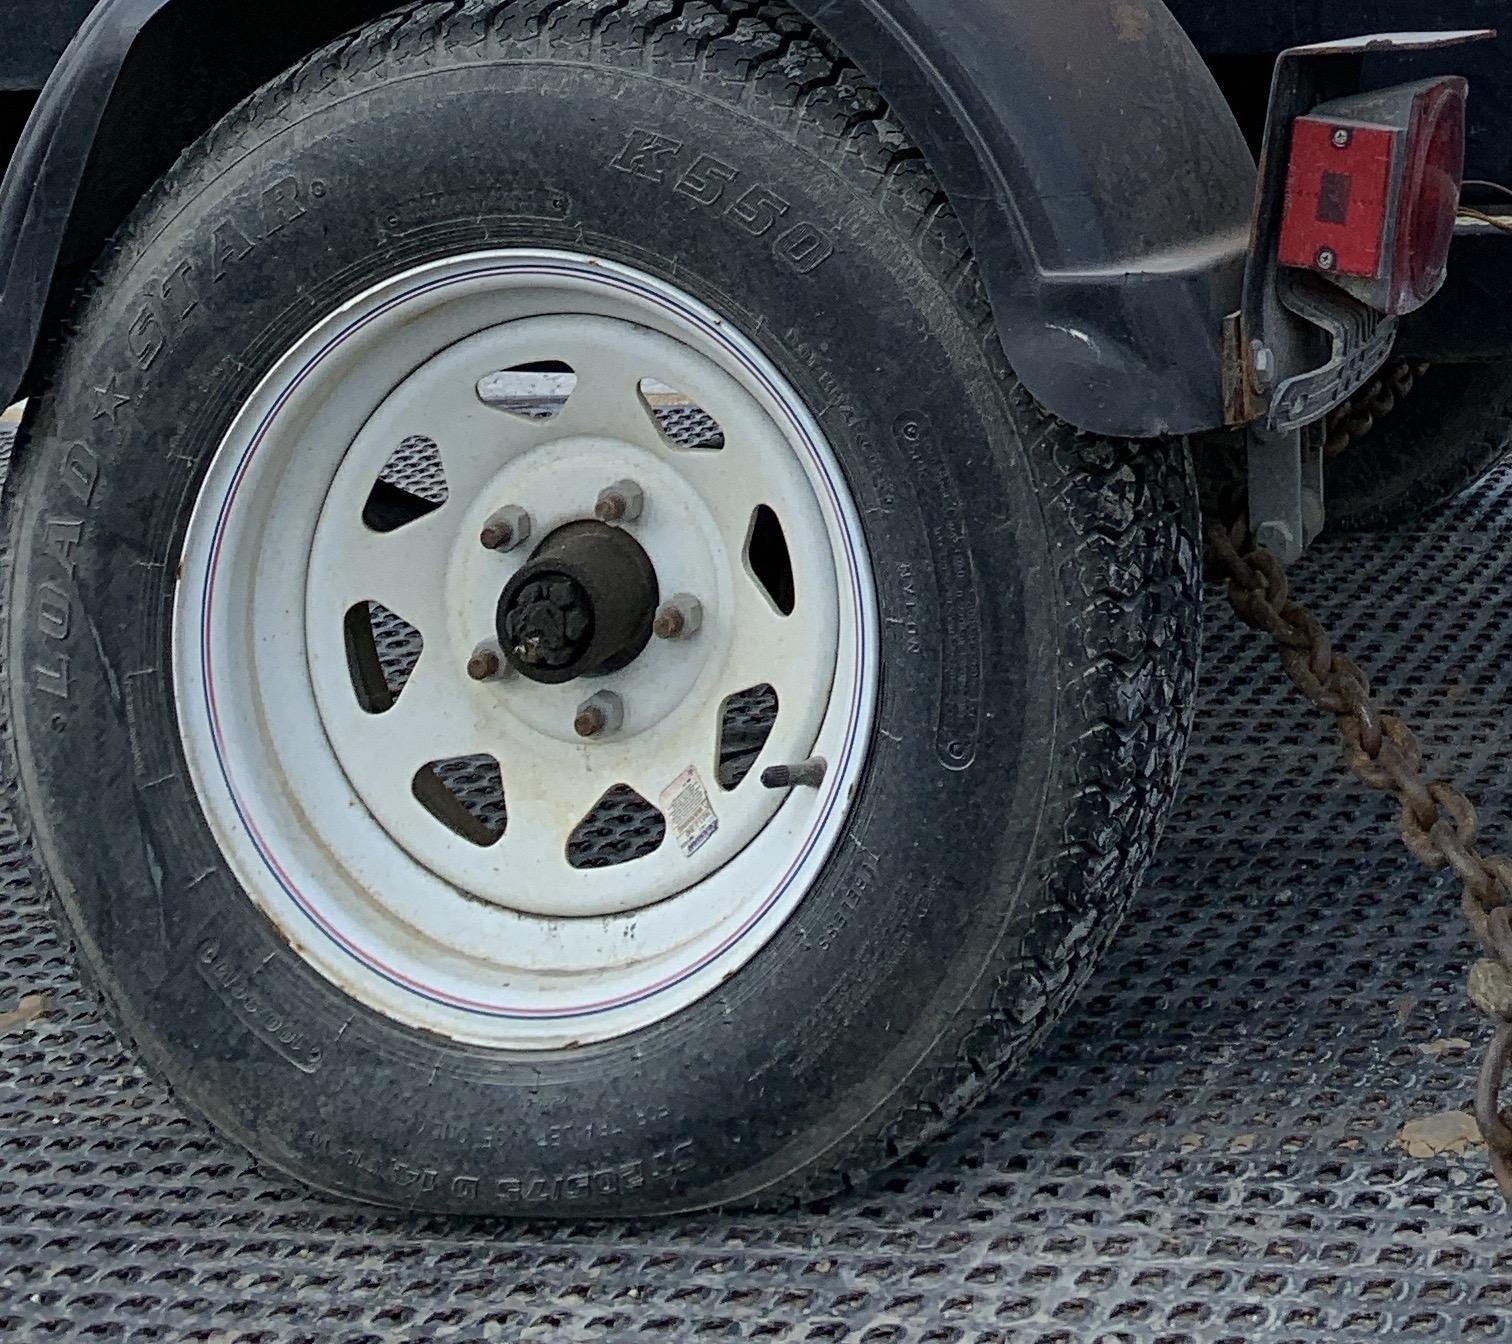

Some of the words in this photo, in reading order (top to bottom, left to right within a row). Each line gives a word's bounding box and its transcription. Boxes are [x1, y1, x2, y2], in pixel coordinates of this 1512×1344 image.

[608, 126, 834, 274] K550
[37, 441, 99, 702] LOAD
[127, 174, 306, 371] STAR
